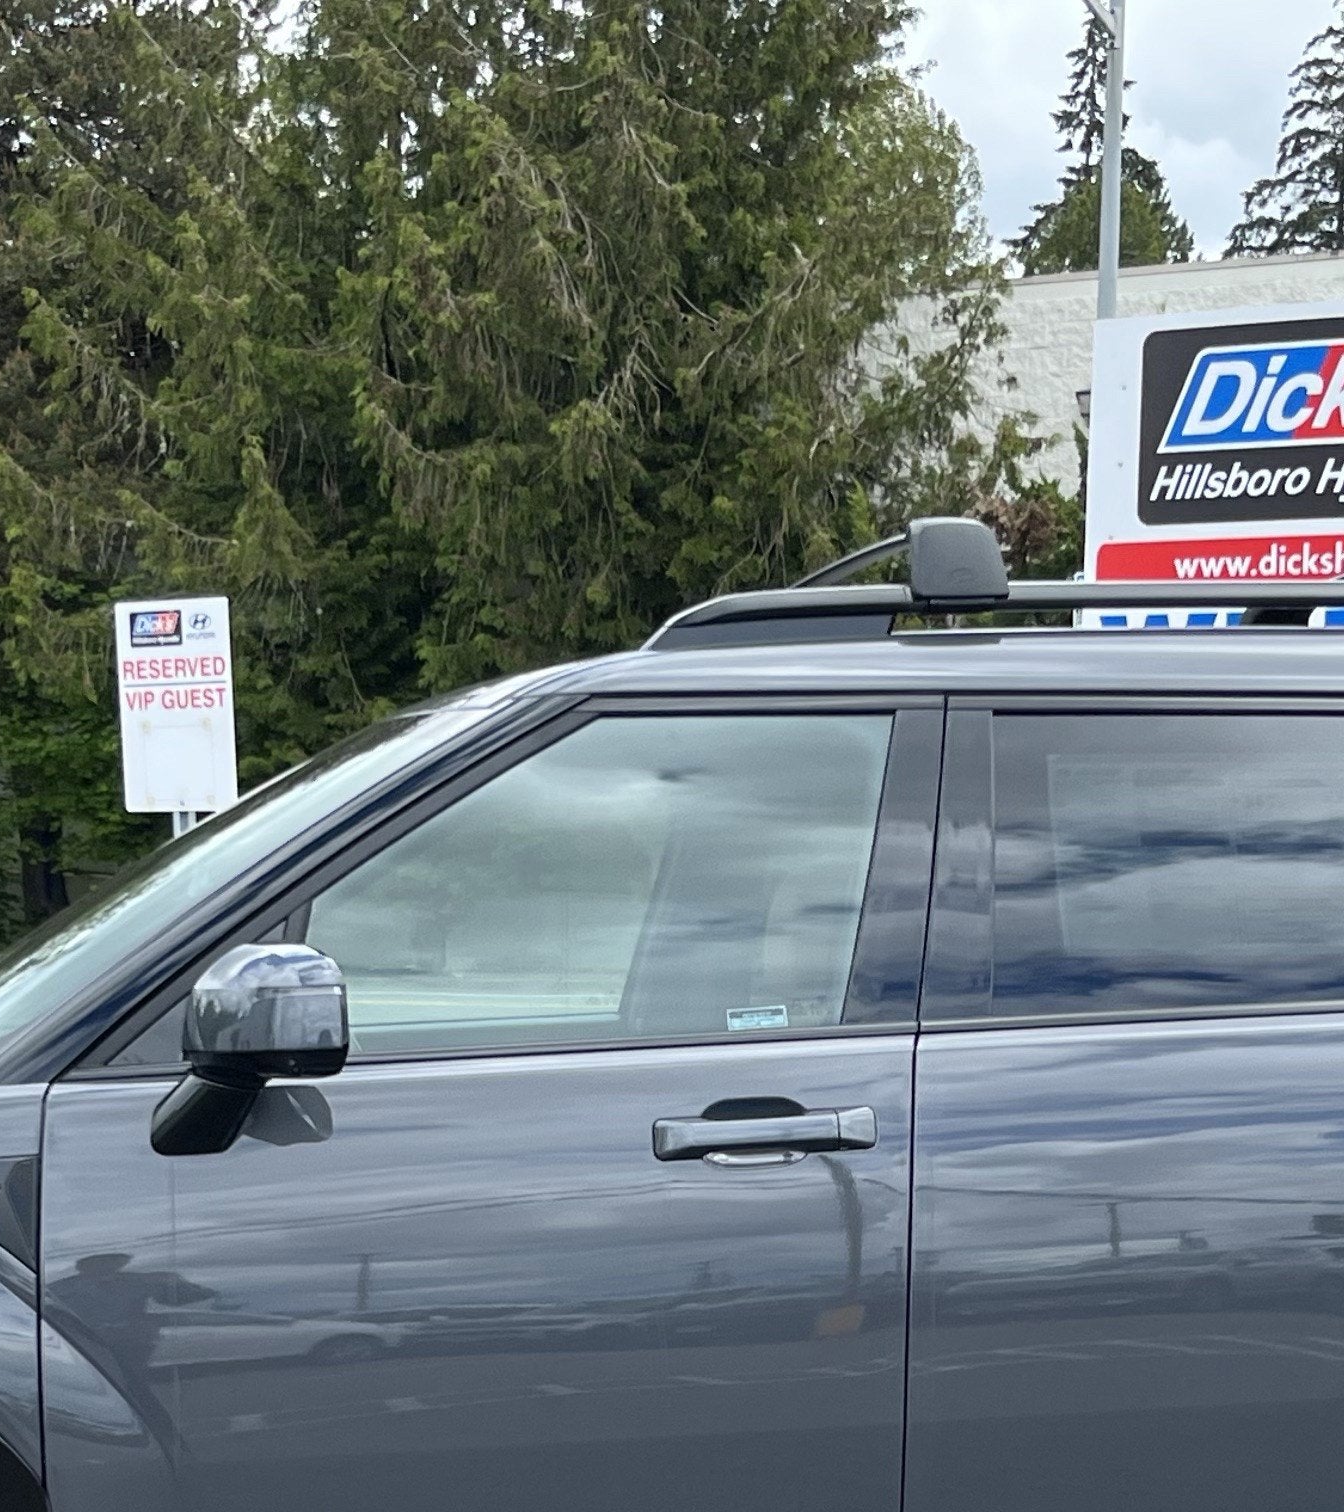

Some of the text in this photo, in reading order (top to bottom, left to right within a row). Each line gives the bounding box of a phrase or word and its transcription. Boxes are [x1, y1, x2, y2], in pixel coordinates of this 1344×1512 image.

[1150, 462, 1311, 501] Hillsboro
[123, 656, 226, 680] RESERVED
[125, 688, 226, 710] VIP GUEST
